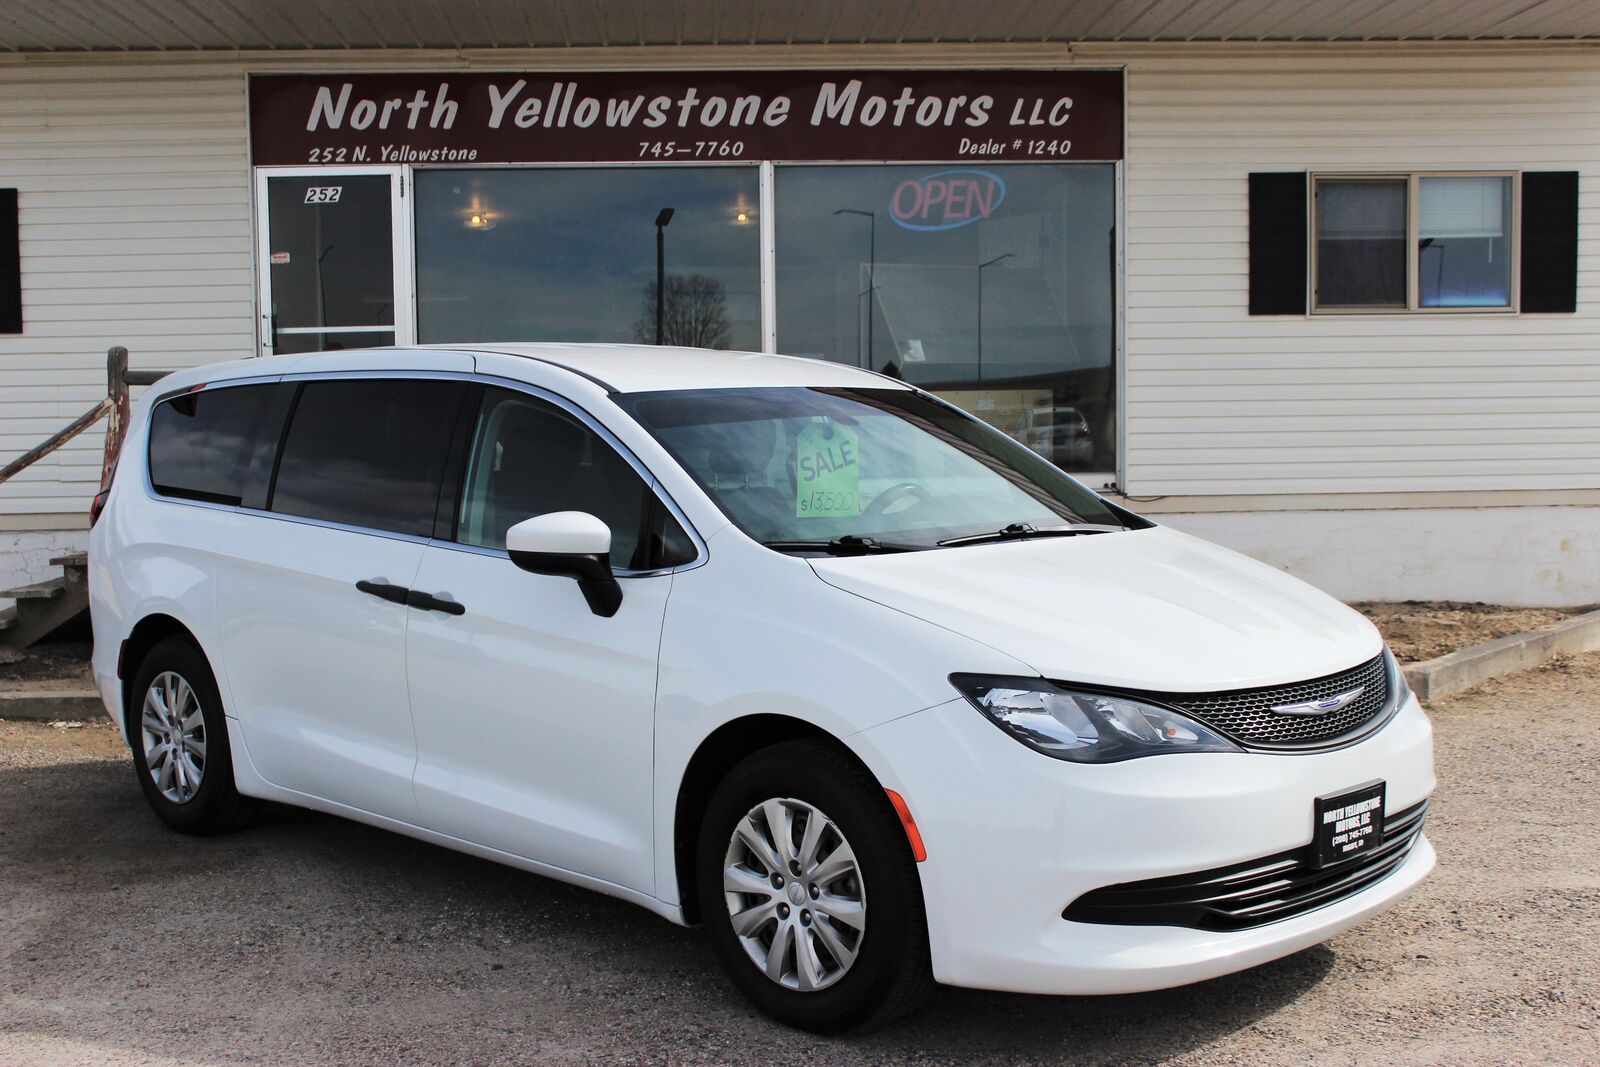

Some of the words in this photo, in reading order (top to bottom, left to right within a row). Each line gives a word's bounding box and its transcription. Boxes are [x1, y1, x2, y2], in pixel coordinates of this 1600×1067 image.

[306, 82, 459, 132] North
[488, 79, 791, 129] Yellowstone
[810, 79, 994, 127] Motors
[1009, 96, 1073, 127] LLC
[308, 147, 347, 163] 252
[352, 145, 371, 163] N.
[380, 144, 478, 163] Yellowstone
[639, 140, 744, 158] 745-7760
[958, 138, 1006, 155] Dealer
[1027, 139, 1072, 156] 1240
[306, 188, 340, 202] 252
[892, 180, 995, 220] OPEN
[799, 440, 857, 482] SALE
[1323, 807, 1345, 825] NORTH
